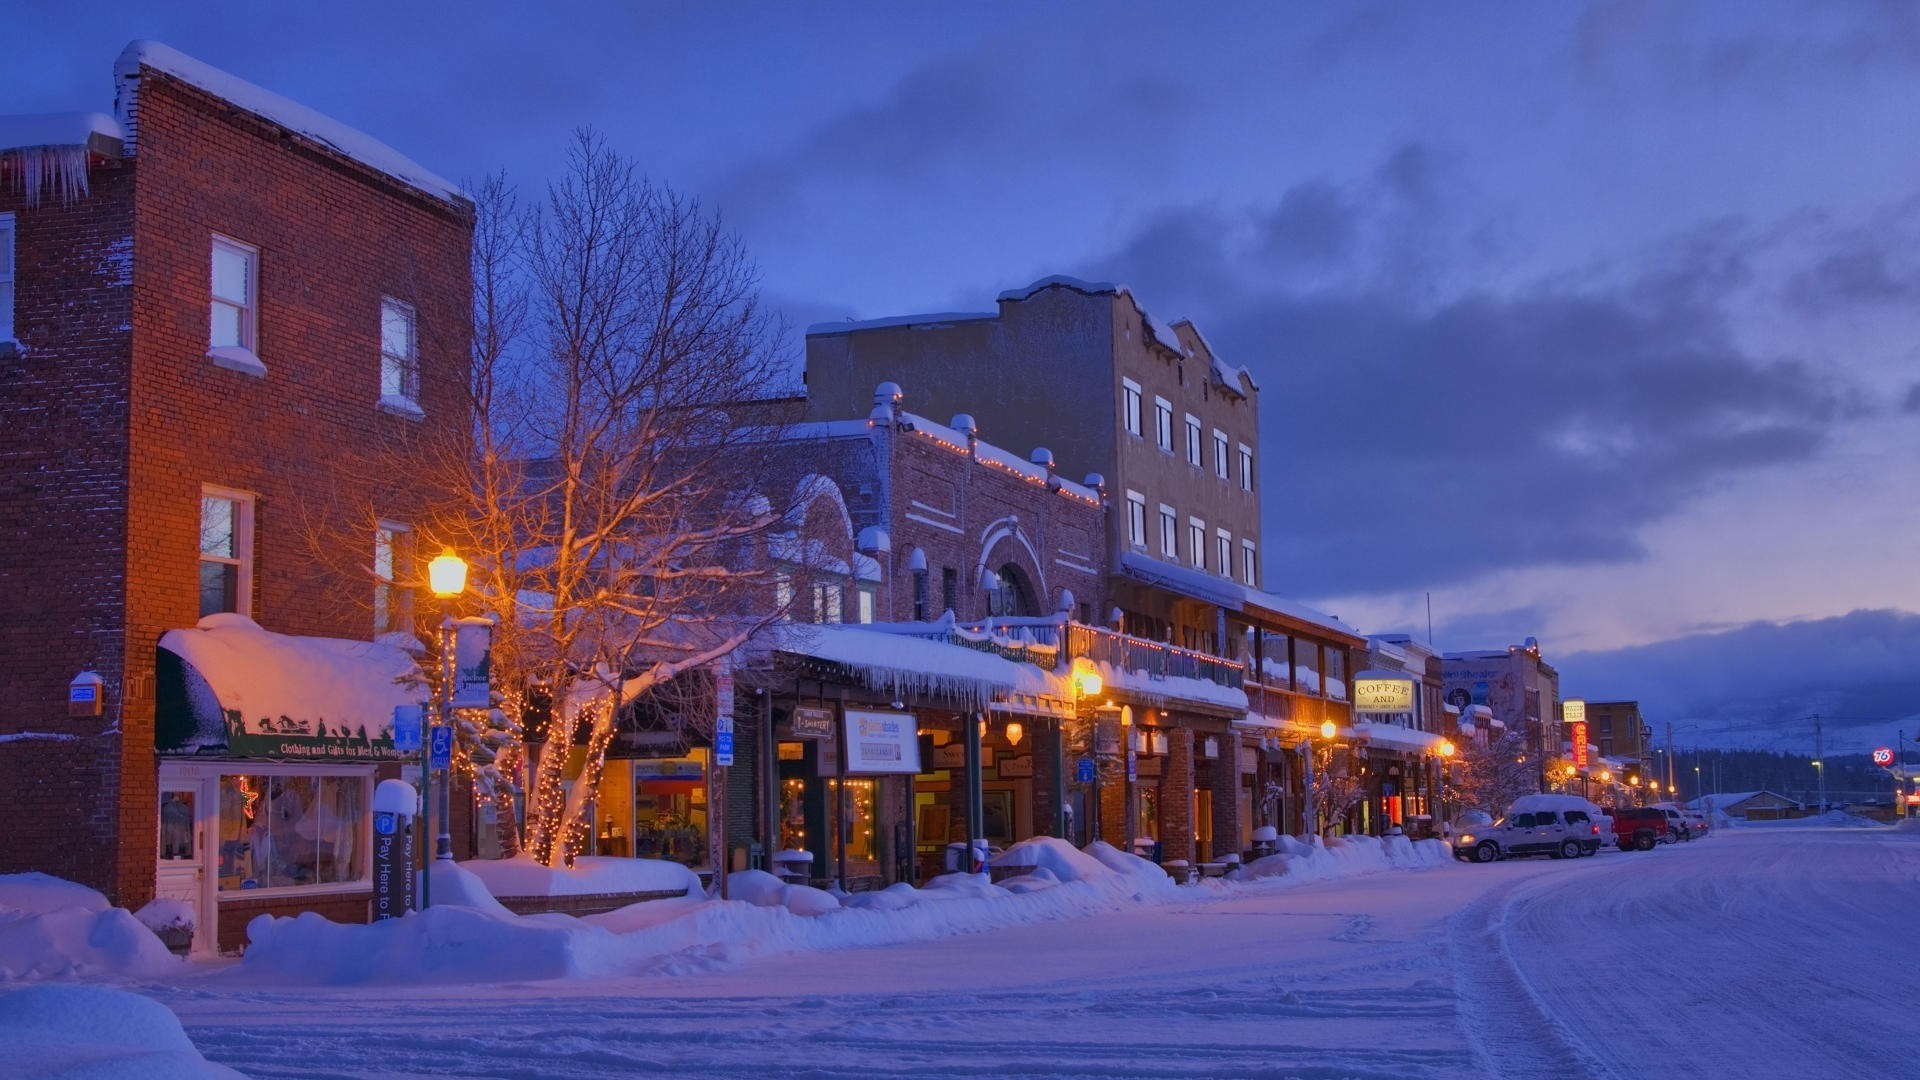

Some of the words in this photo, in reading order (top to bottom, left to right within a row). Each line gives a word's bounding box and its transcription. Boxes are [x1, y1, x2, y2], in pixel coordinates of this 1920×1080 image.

[1358, 684, 1409, 695] COFFEE
[281, 743, 310, 756] Clothing
[311, 746, 326, 755] and
[381, 747, 403, 758] Wome
[1874, 749, 1890, 762] 76
[379, 837, 391, 860] Pay
[404, 835, 412, 858] Pay
[380, 864, 391, 893] Here
[404, 861, 412, 891] Here
[380, 897, 389, 909] to
[404, 894, 411, 906] to
